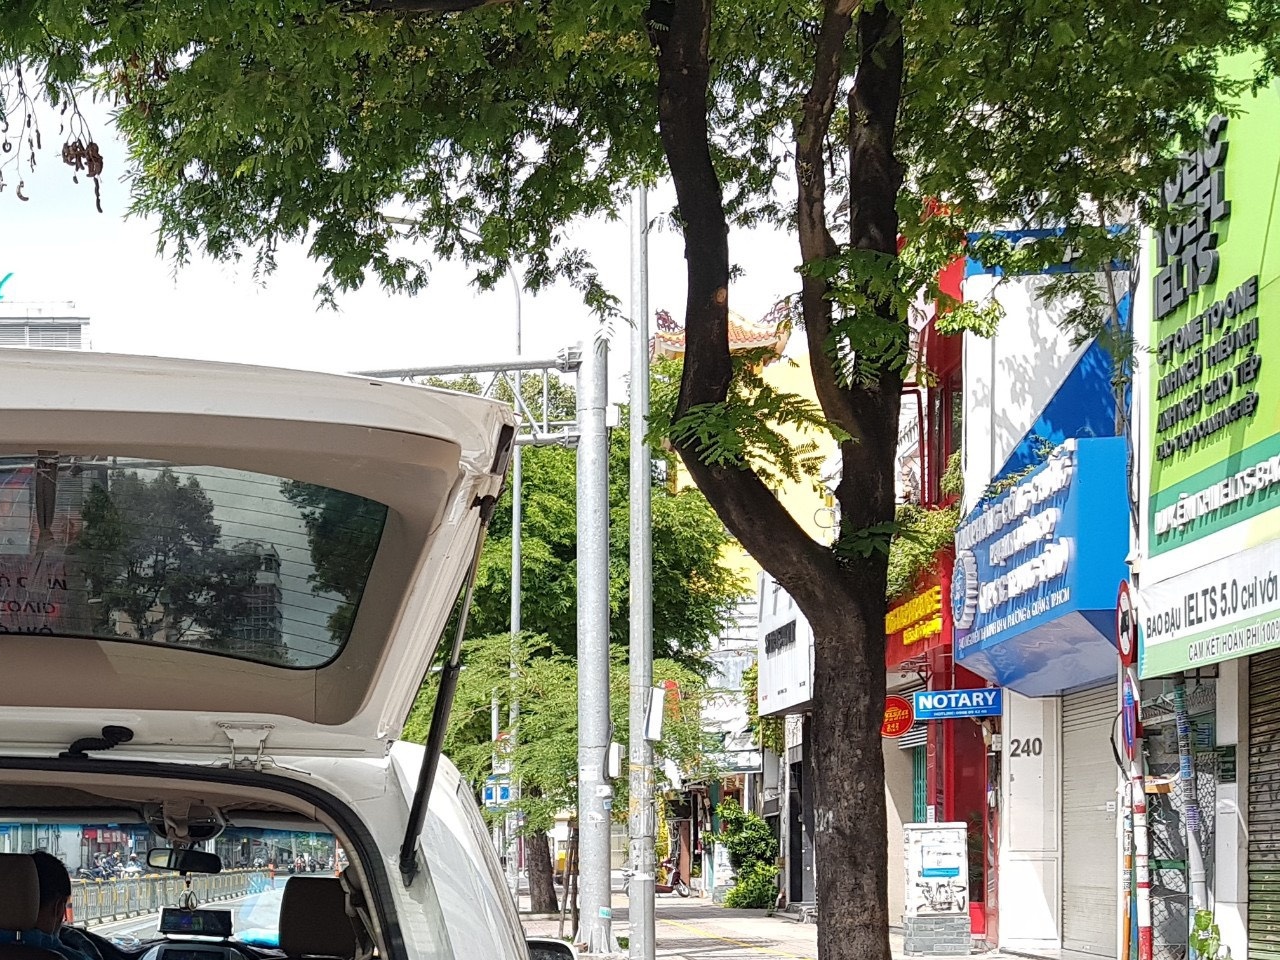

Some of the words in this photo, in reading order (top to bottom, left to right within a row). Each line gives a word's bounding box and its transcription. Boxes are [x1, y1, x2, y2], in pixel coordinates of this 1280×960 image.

[1153, 232, 1219, 322] IELTS
[1173, 314, 1203, 353] ONE
[1202, 302, 1223, 334] TO
[1223, 275, 1259, 317] ONE
[1234, 317, 1259, 348] NHI
[1203, 371, 1233, 405] GIAO
[1217, 467, 1255, 504] IELTS
[1147, 613, 1163, 639] BAO
[1164, 607, 1181, 638] ĐẬU
[1184, 586, 1217, 628] IELTS
[1220, 578, 1238, 617] 5.0
[1241, 576, 1258, 610] CHỈ
[1259, 570, 1278, 605] VỚI
[1188, 644, 1204, 661] CAM
[1206, 632, 1220, 656] KẾT
[1222, 628, 1244, 653] HOÀN
[1247, 620, 1260, 646] PHÍ
[918, 691, 997, 710] NOTARY
[1010, 738, 1042, 758] 240
